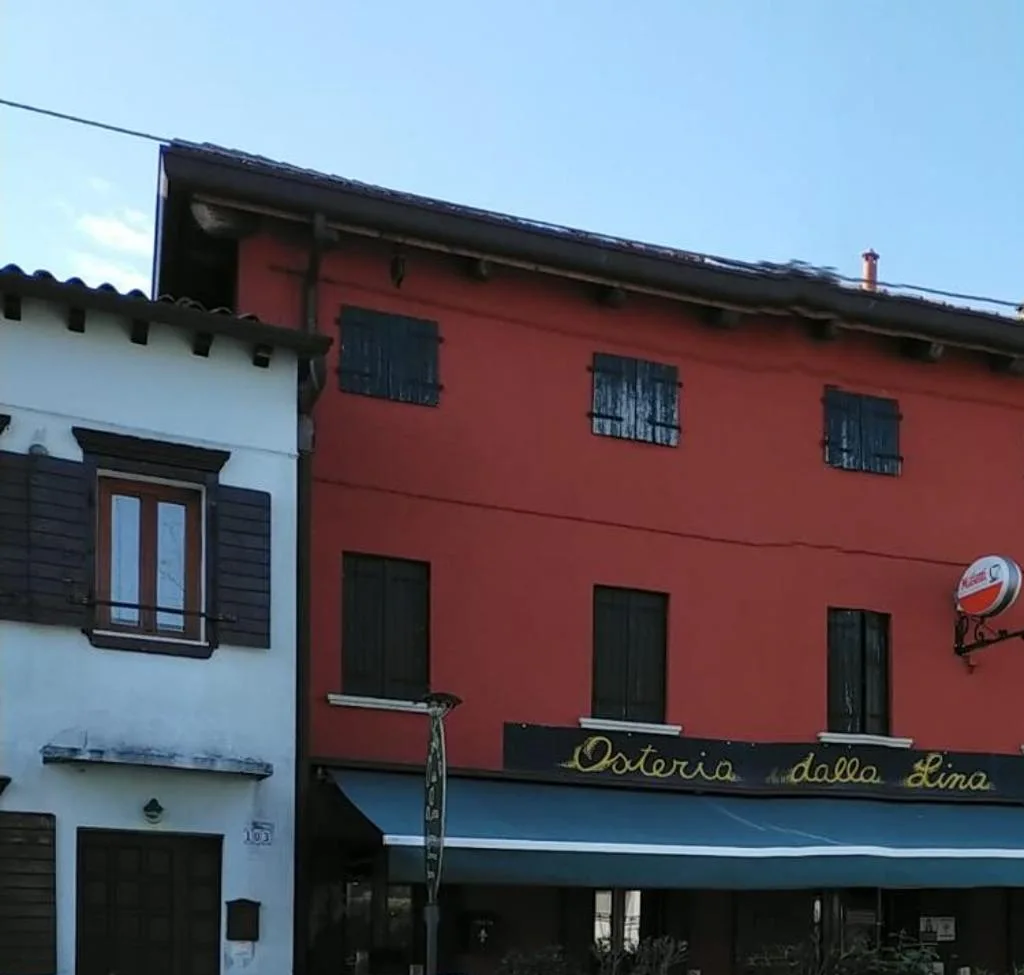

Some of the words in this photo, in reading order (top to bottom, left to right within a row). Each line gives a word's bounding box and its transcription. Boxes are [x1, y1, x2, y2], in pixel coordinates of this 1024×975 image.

[573, 735, 739, 783] Osteria
[788, 752, 882, 784] dalla
[906, 753, 991, 791] Lina
